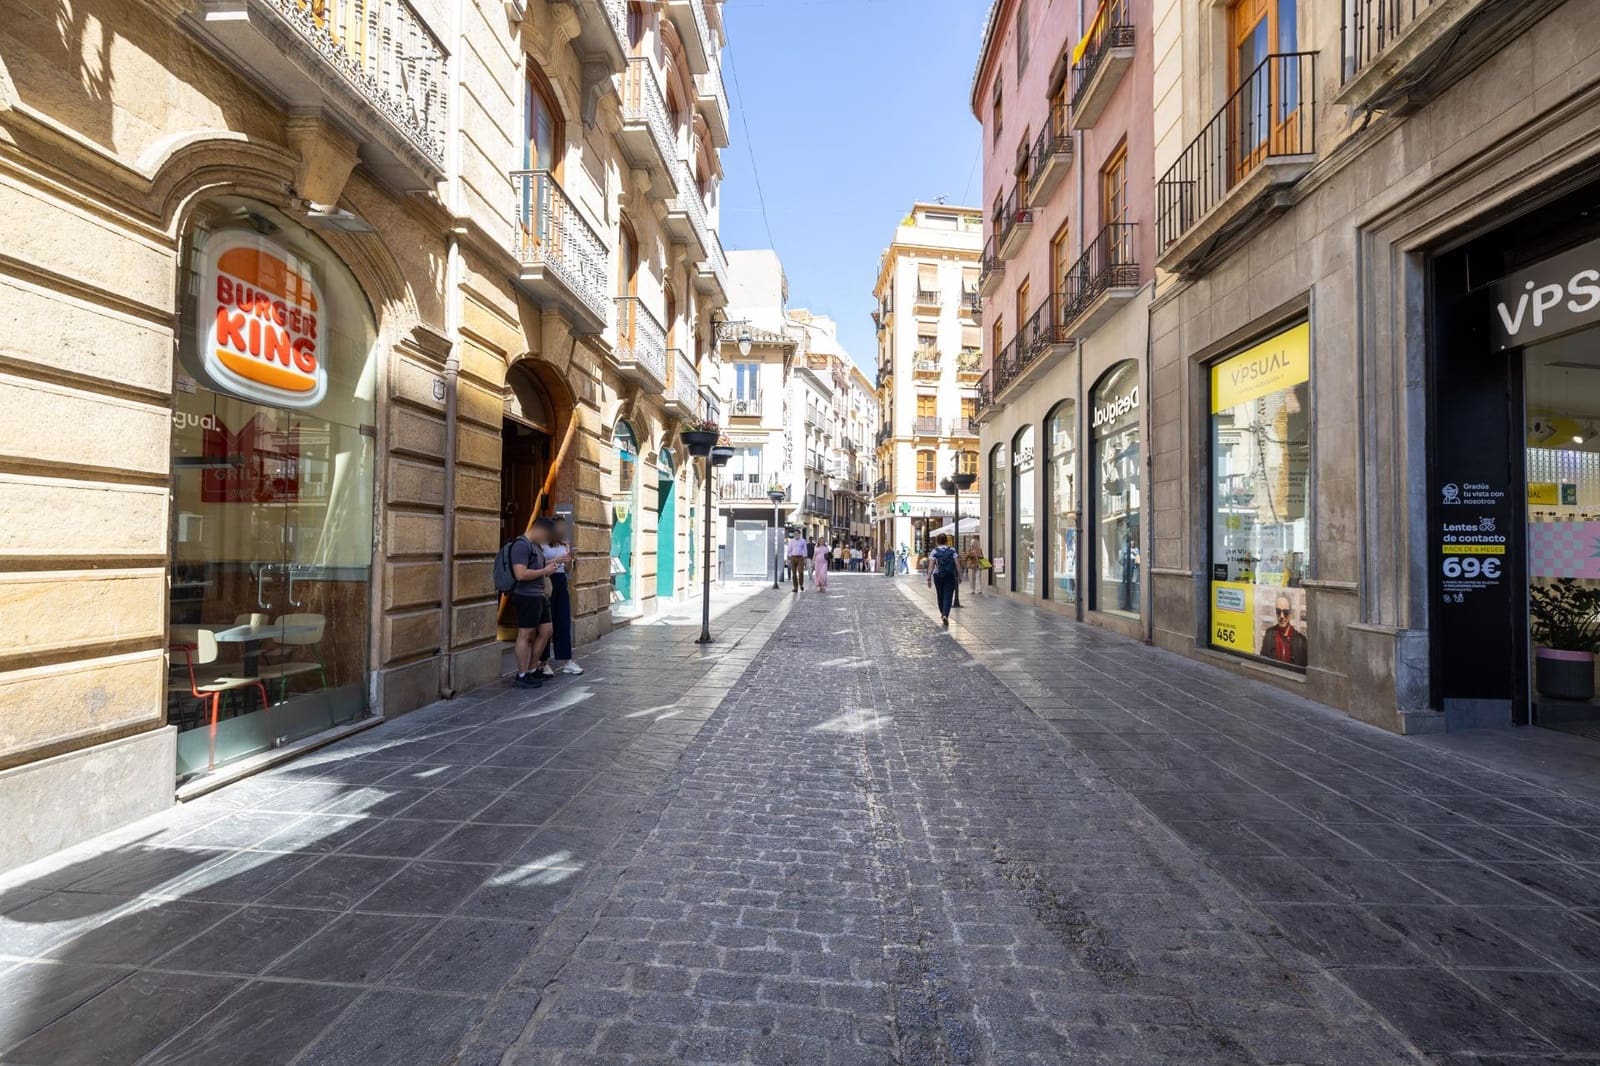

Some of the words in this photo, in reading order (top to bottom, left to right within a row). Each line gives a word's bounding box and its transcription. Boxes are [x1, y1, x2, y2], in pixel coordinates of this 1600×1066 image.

[216, 275, 317, 340] BURGER
[216, 305, 316, 374] KING
[1443, 523, 1478, 531] Lentes
[1443, 534, 1457, 542] de
[1458, 534, 1506, 542] contacto
[1442, 557, 1502, 578] 69€
[1216, 628, 1236, 643] 45€
